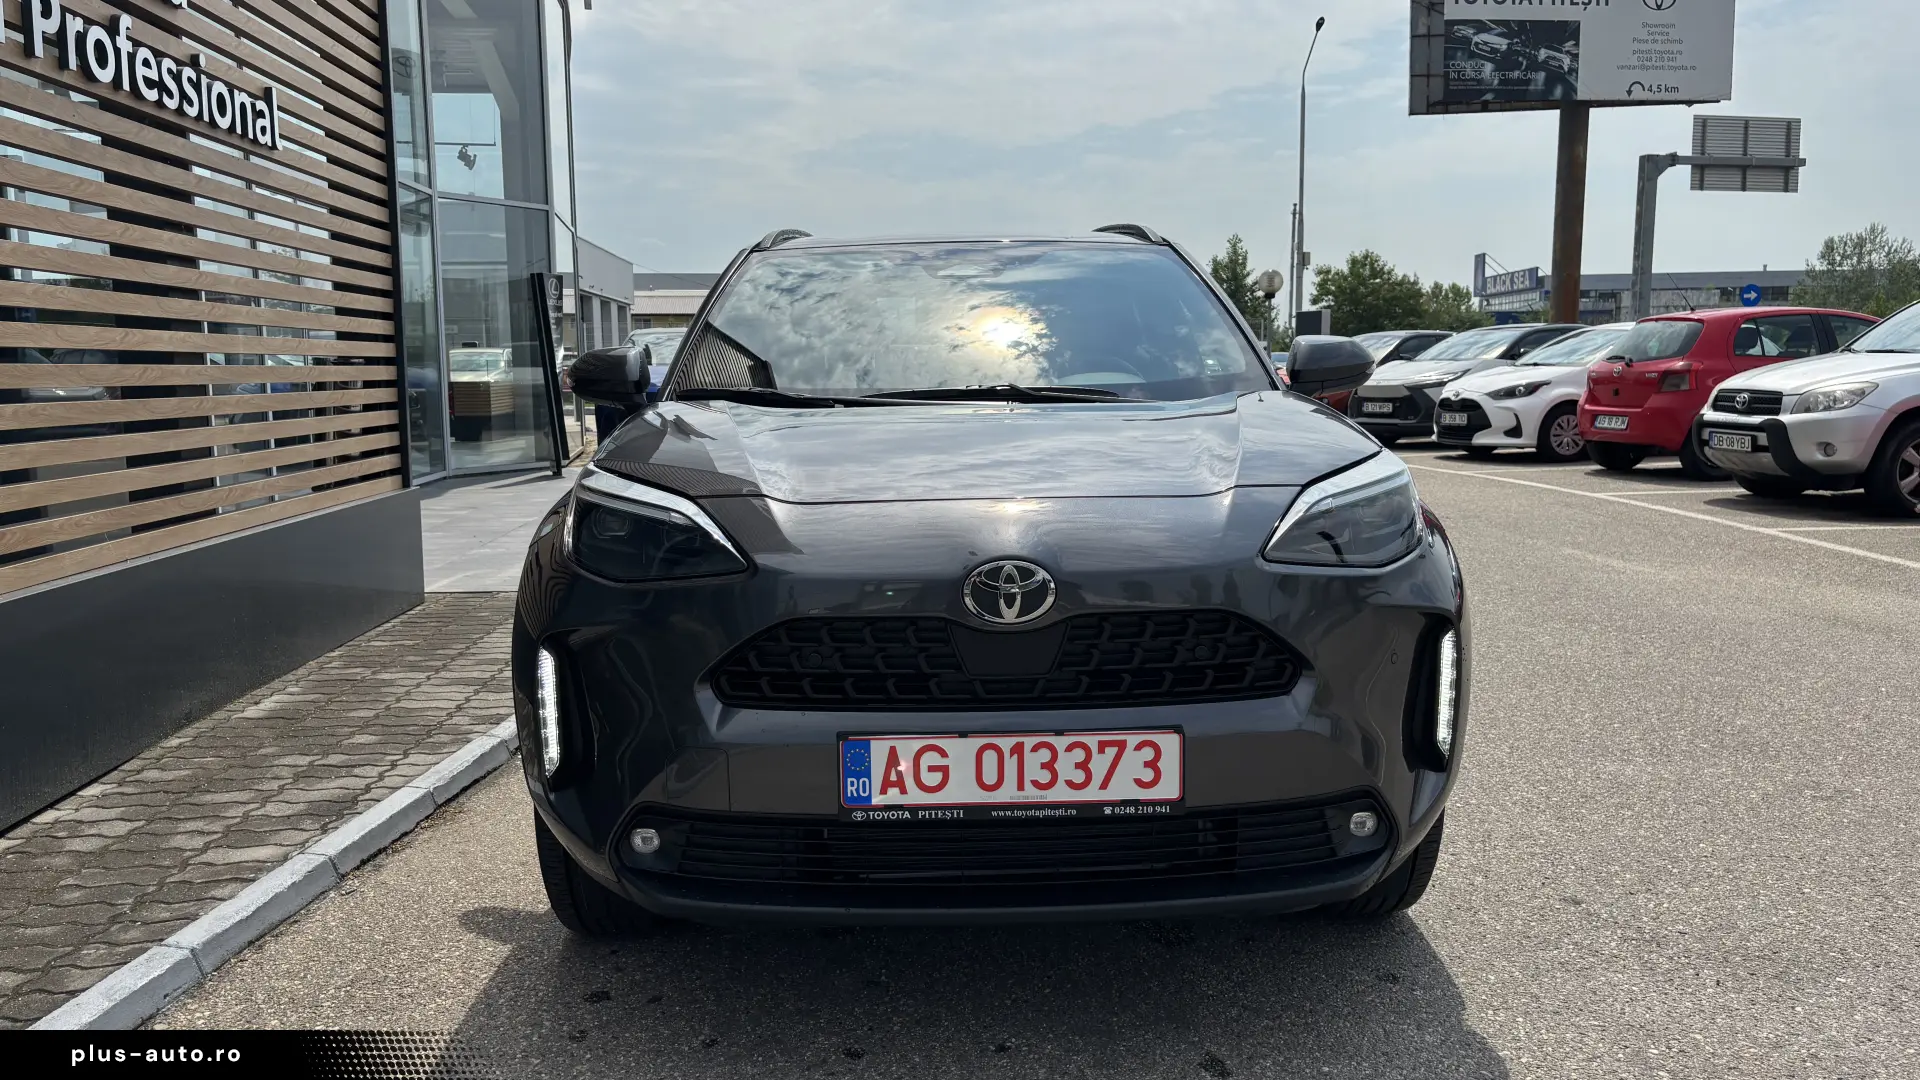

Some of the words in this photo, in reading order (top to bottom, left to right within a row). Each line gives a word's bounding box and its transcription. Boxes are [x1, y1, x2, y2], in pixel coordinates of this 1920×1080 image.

[1641, 21, 1676, 29] Showroom
[1646, 29, 1670, 37] Service
[1650, 37, 1659, 45] de
[1660, 37, 1684, 45] schimb
[1632, 48, 1683, 56] pitesti.toyota.ro
[30, 0, 283, 151] Professional
[1459, 71, 1485, 79] CURSA
[1646, 84, 1663, 95] 4,5
[1664, 84, 1680, 94] km
[1486, 274, 1512, 294] BLACK
[1513, 270, 1530, 289] SEA
[1713, 435, 1724, 447] DB
[1725, 436, 1735, 448] 08
[1736, 437, 1750, 450] YBJ
[879, 743, 950, 796] AG
[975, 739, 1163, 793] 013373
[847, 777, 870, 797] RO
[867, 811, 911, 820] TOYOTA
[918, 809, 964, 820] PITEȘTI
[1114, 806, 1136, 815] 0248
[1137, 805, 1153, 814] 210
[1155, 805, 1170, 814] 941
